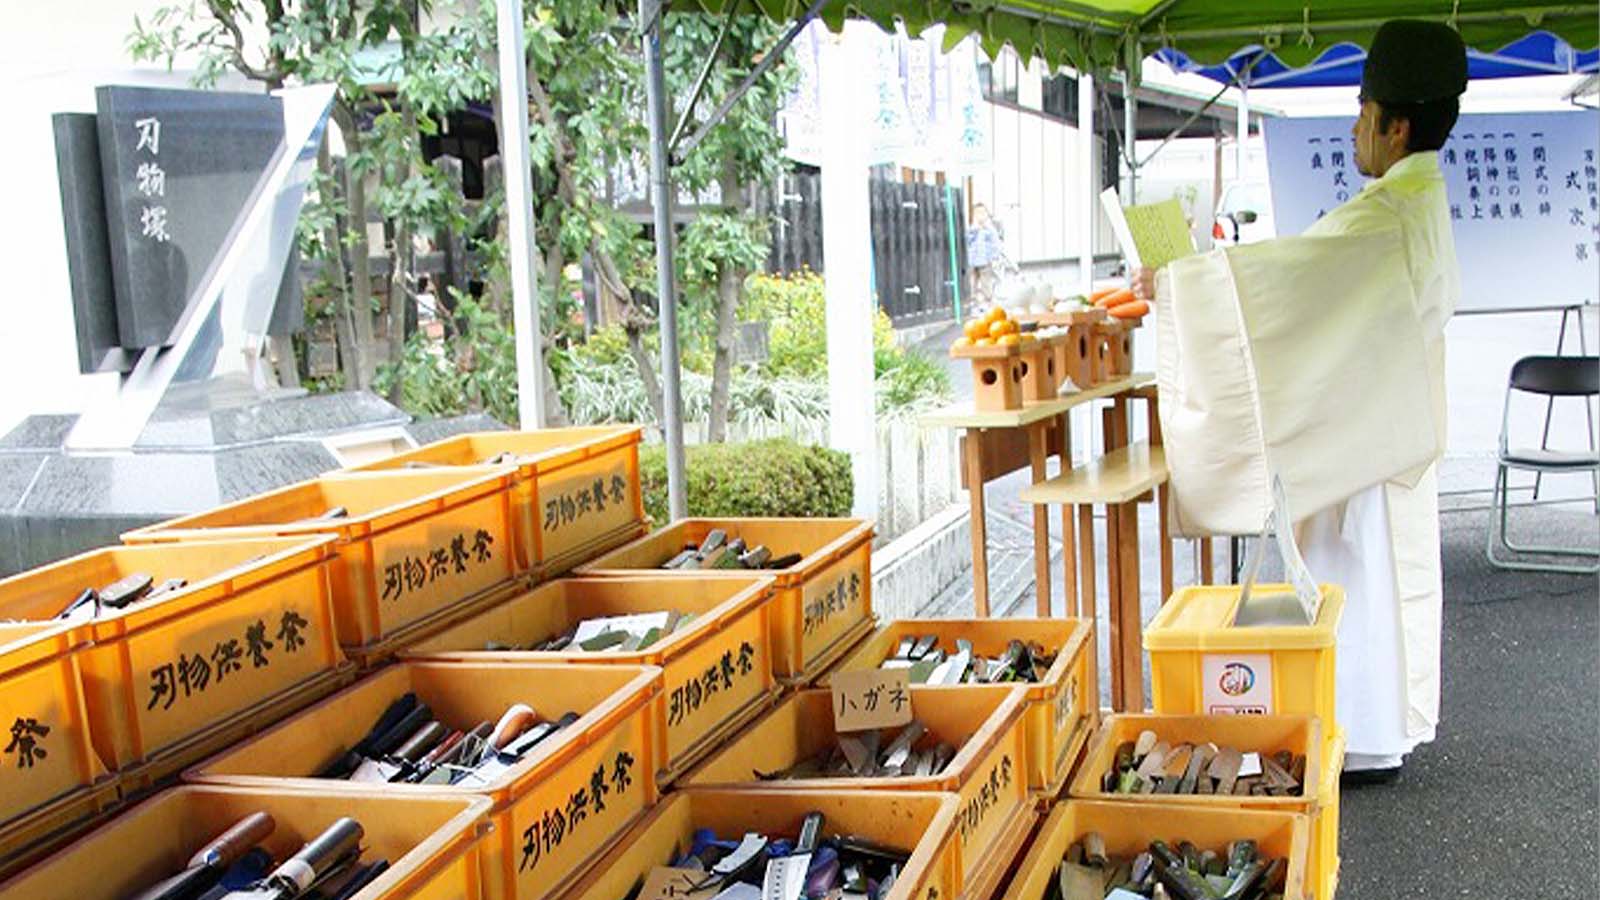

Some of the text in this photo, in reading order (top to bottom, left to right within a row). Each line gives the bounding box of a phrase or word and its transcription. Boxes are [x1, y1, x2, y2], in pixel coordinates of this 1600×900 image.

[135, 116, 171, 242] 刃物塚
[543, 474, 626, 531] 刃物供養祭
[382, 528, 494, 601] 刃物供養祭
[802, 572, 860, 635] 刃物供養祭
[147, 610, 308, 711] 刃物供養祭
[668, 641, 754, 727] 刃物供養祭
[840, 681, 908, 718] ハガネ
[519, 751, 634, 874] 刃物供養祭
